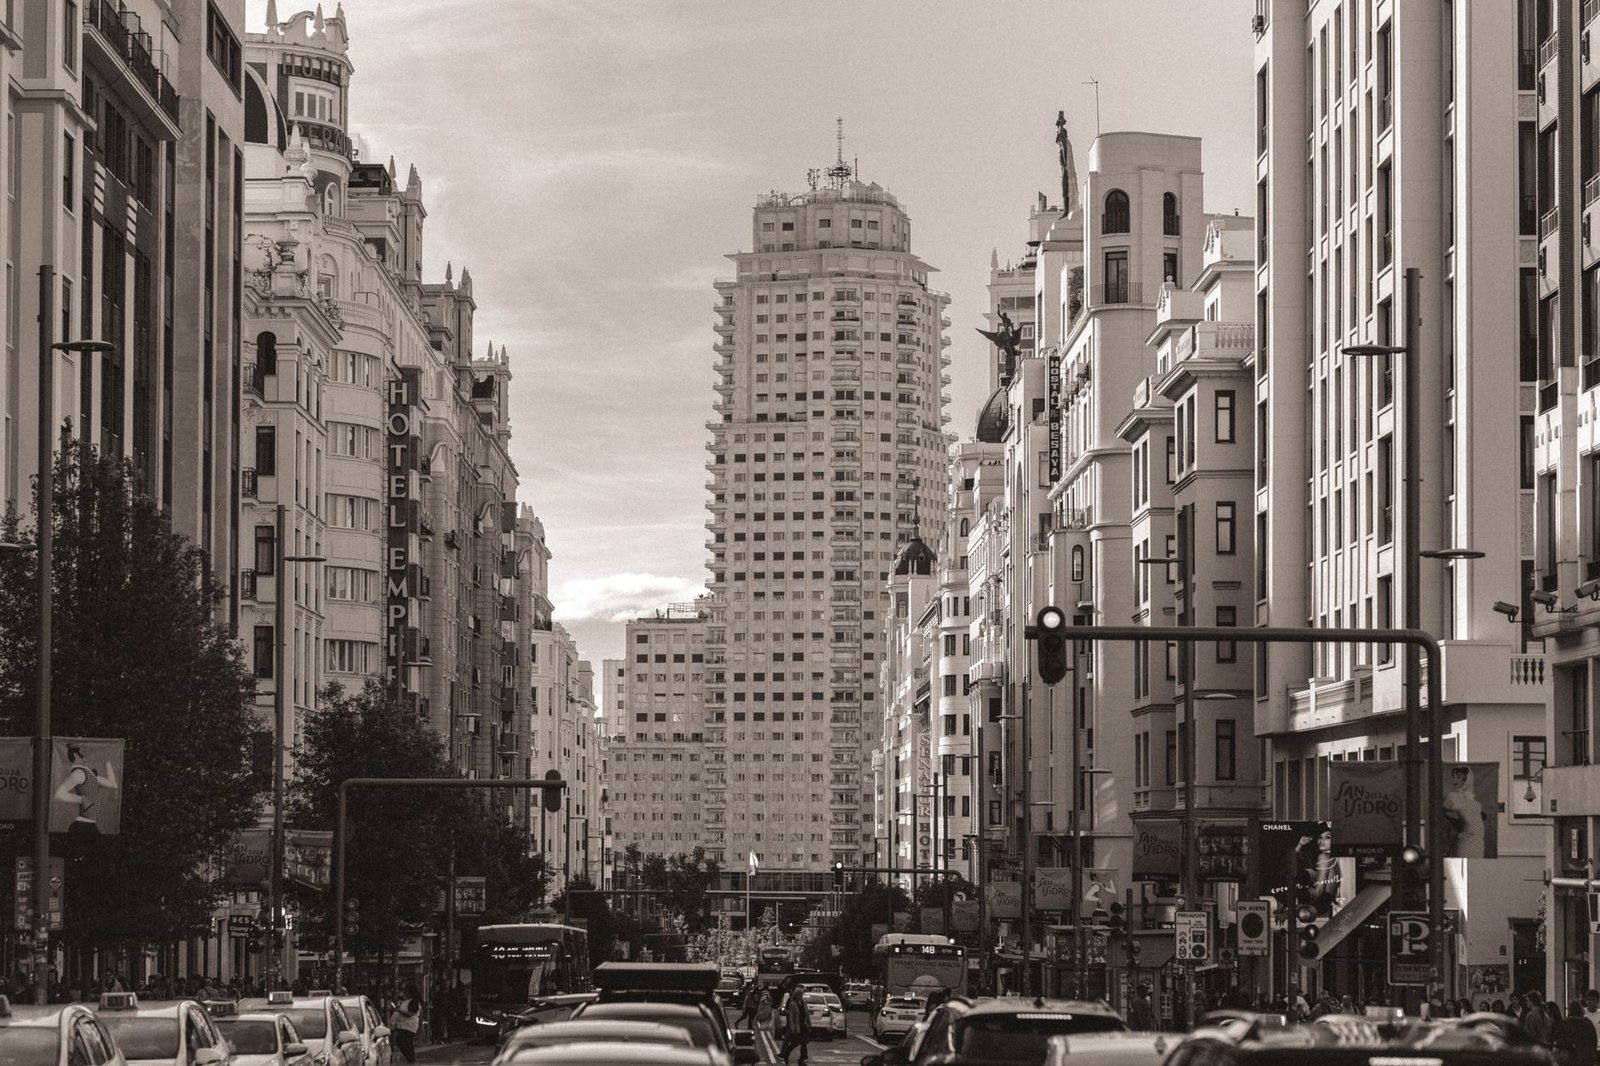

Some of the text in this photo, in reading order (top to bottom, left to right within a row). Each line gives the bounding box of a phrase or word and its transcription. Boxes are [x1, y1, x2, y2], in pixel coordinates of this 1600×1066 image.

[1050, 360, 1059, 405] HOSTAL
[388, 382, 409, 528] HOTEL
[1050, 422, 1059, 476] BESAYA
[918, 735, 931, 817] SENATOR
[1334, 780, 1365, 801] SAN
[1344, 797, 1399, 818] ISIDRO
[1262, 824, 1293, 832] CHANEL
[922, 946, 935, 954] 148
[1396, 920, 1430, 955] P
